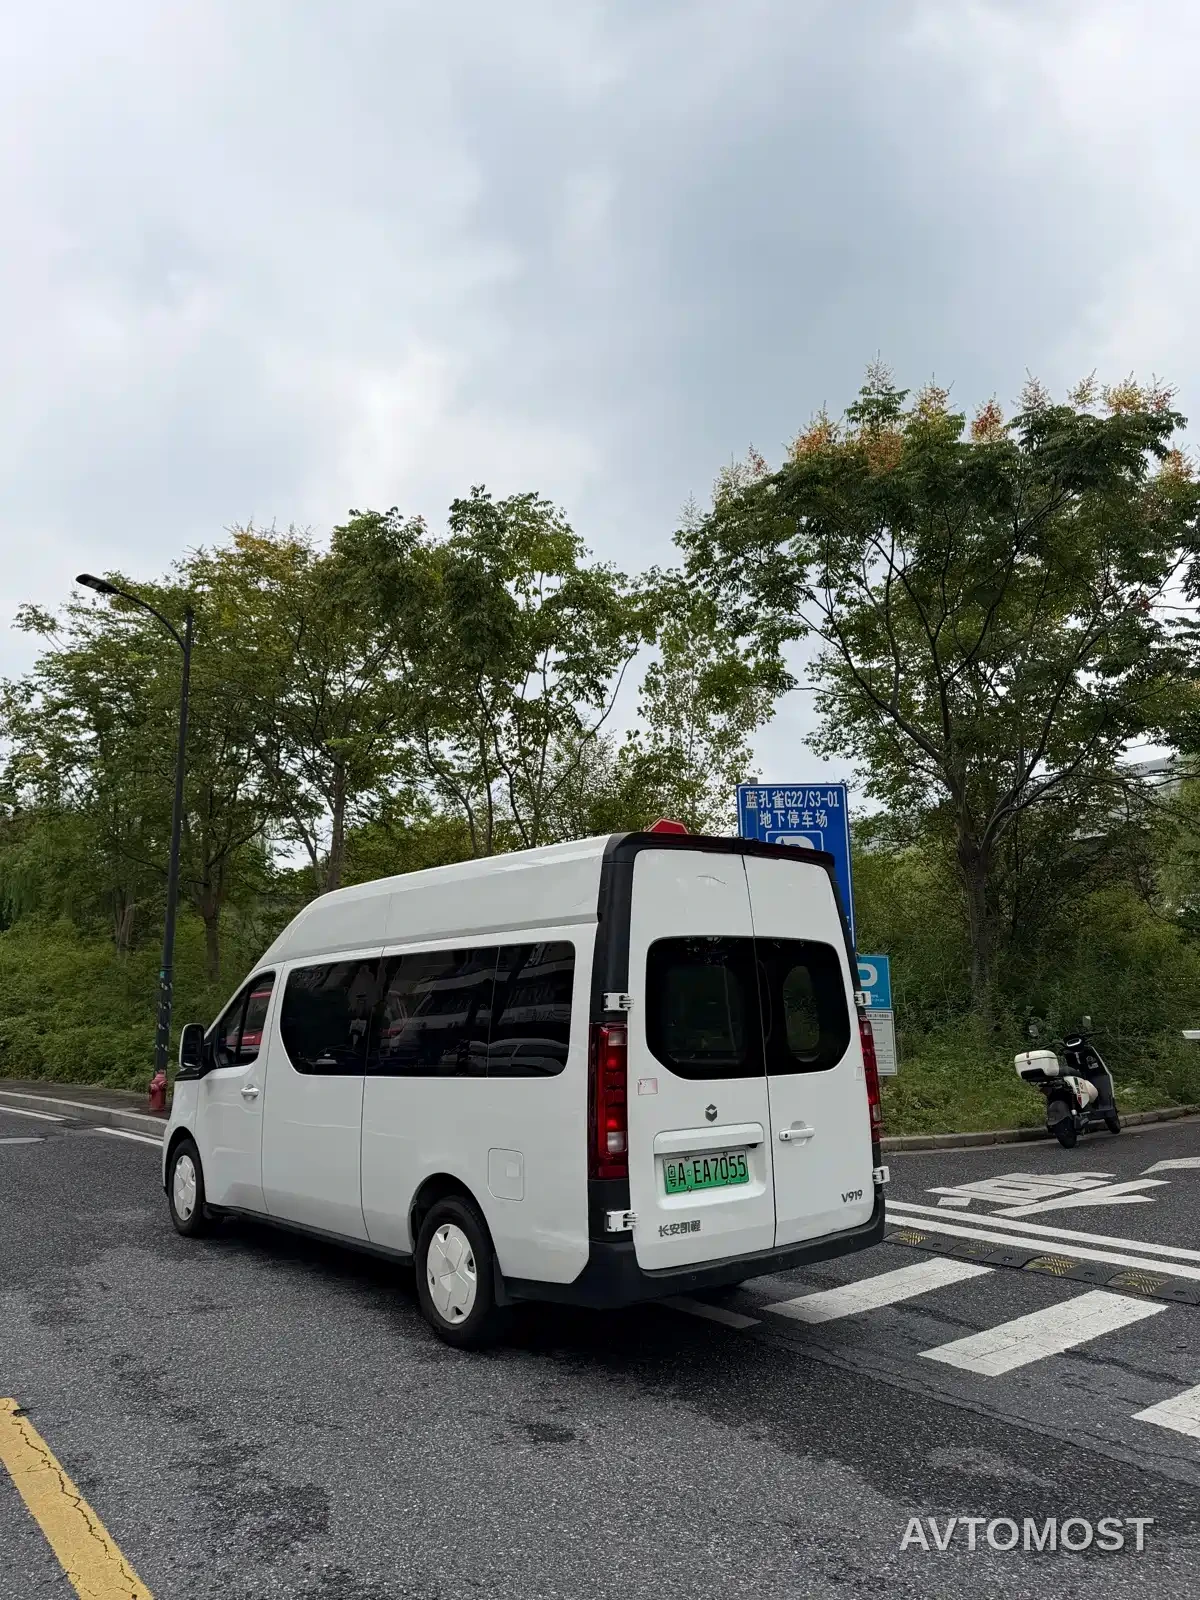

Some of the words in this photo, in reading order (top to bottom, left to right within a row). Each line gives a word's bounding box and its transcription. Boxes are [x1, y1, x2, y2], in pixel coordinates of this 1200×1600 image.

[745, 791, 840, 809] 蓝孔雀G22/S3-01
[759, 809, 828, 829] 地下停车场
[841, 1189, 863, 1203] V919
[658, 1219, 701, 1237] 长安凯程
